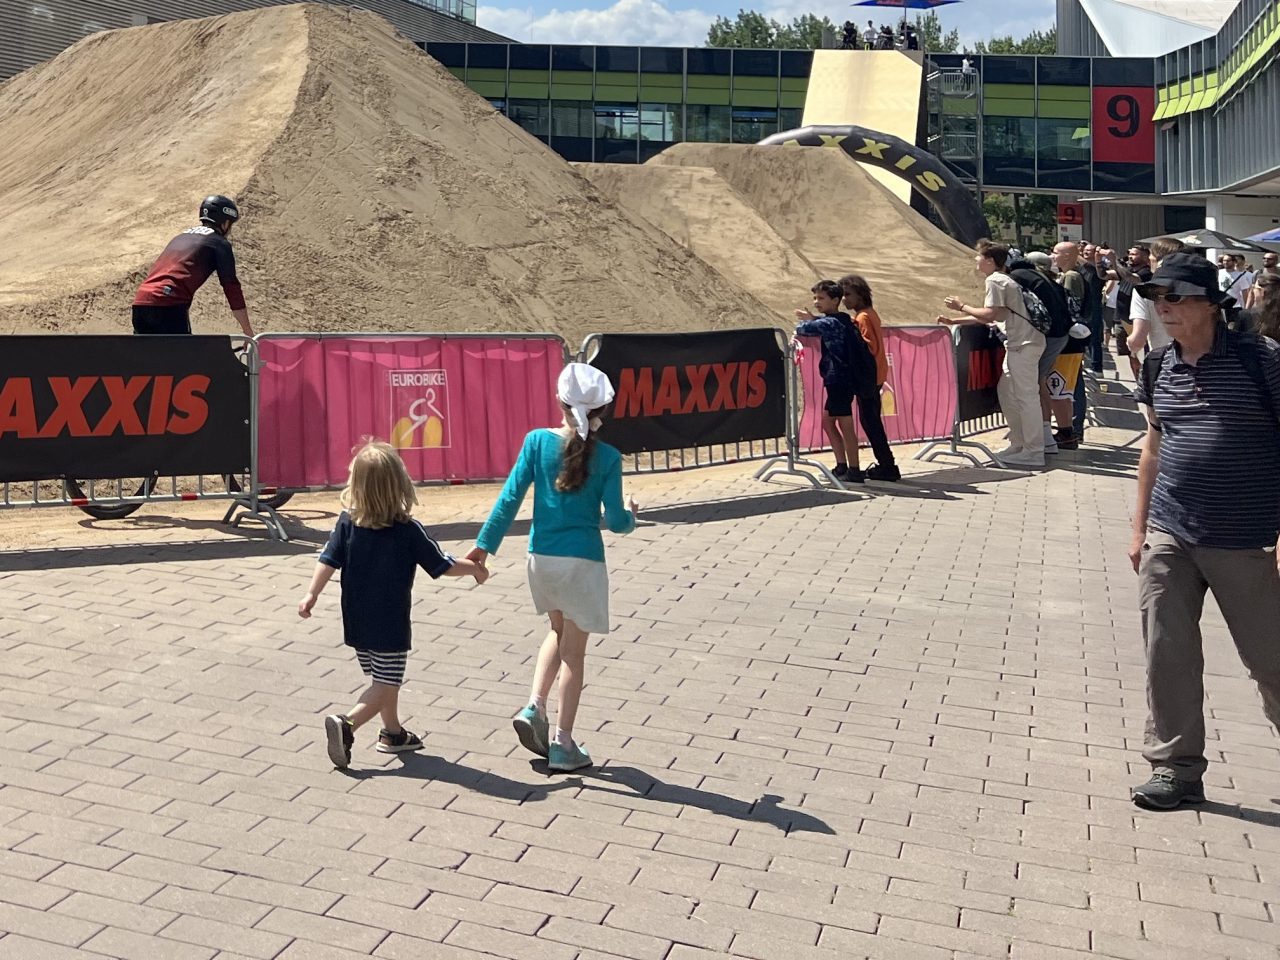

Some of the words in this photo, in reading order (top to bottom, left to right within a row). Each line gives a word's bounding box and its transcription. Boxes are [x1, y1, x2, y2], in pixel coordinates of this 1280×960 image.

[1107, 93, 1140, 139] 9
[1063, 206, 1076, 222] 9
[391, 372, 445, 387] EUROBIKE
[613, 359, 767, 419] MAXXIS
